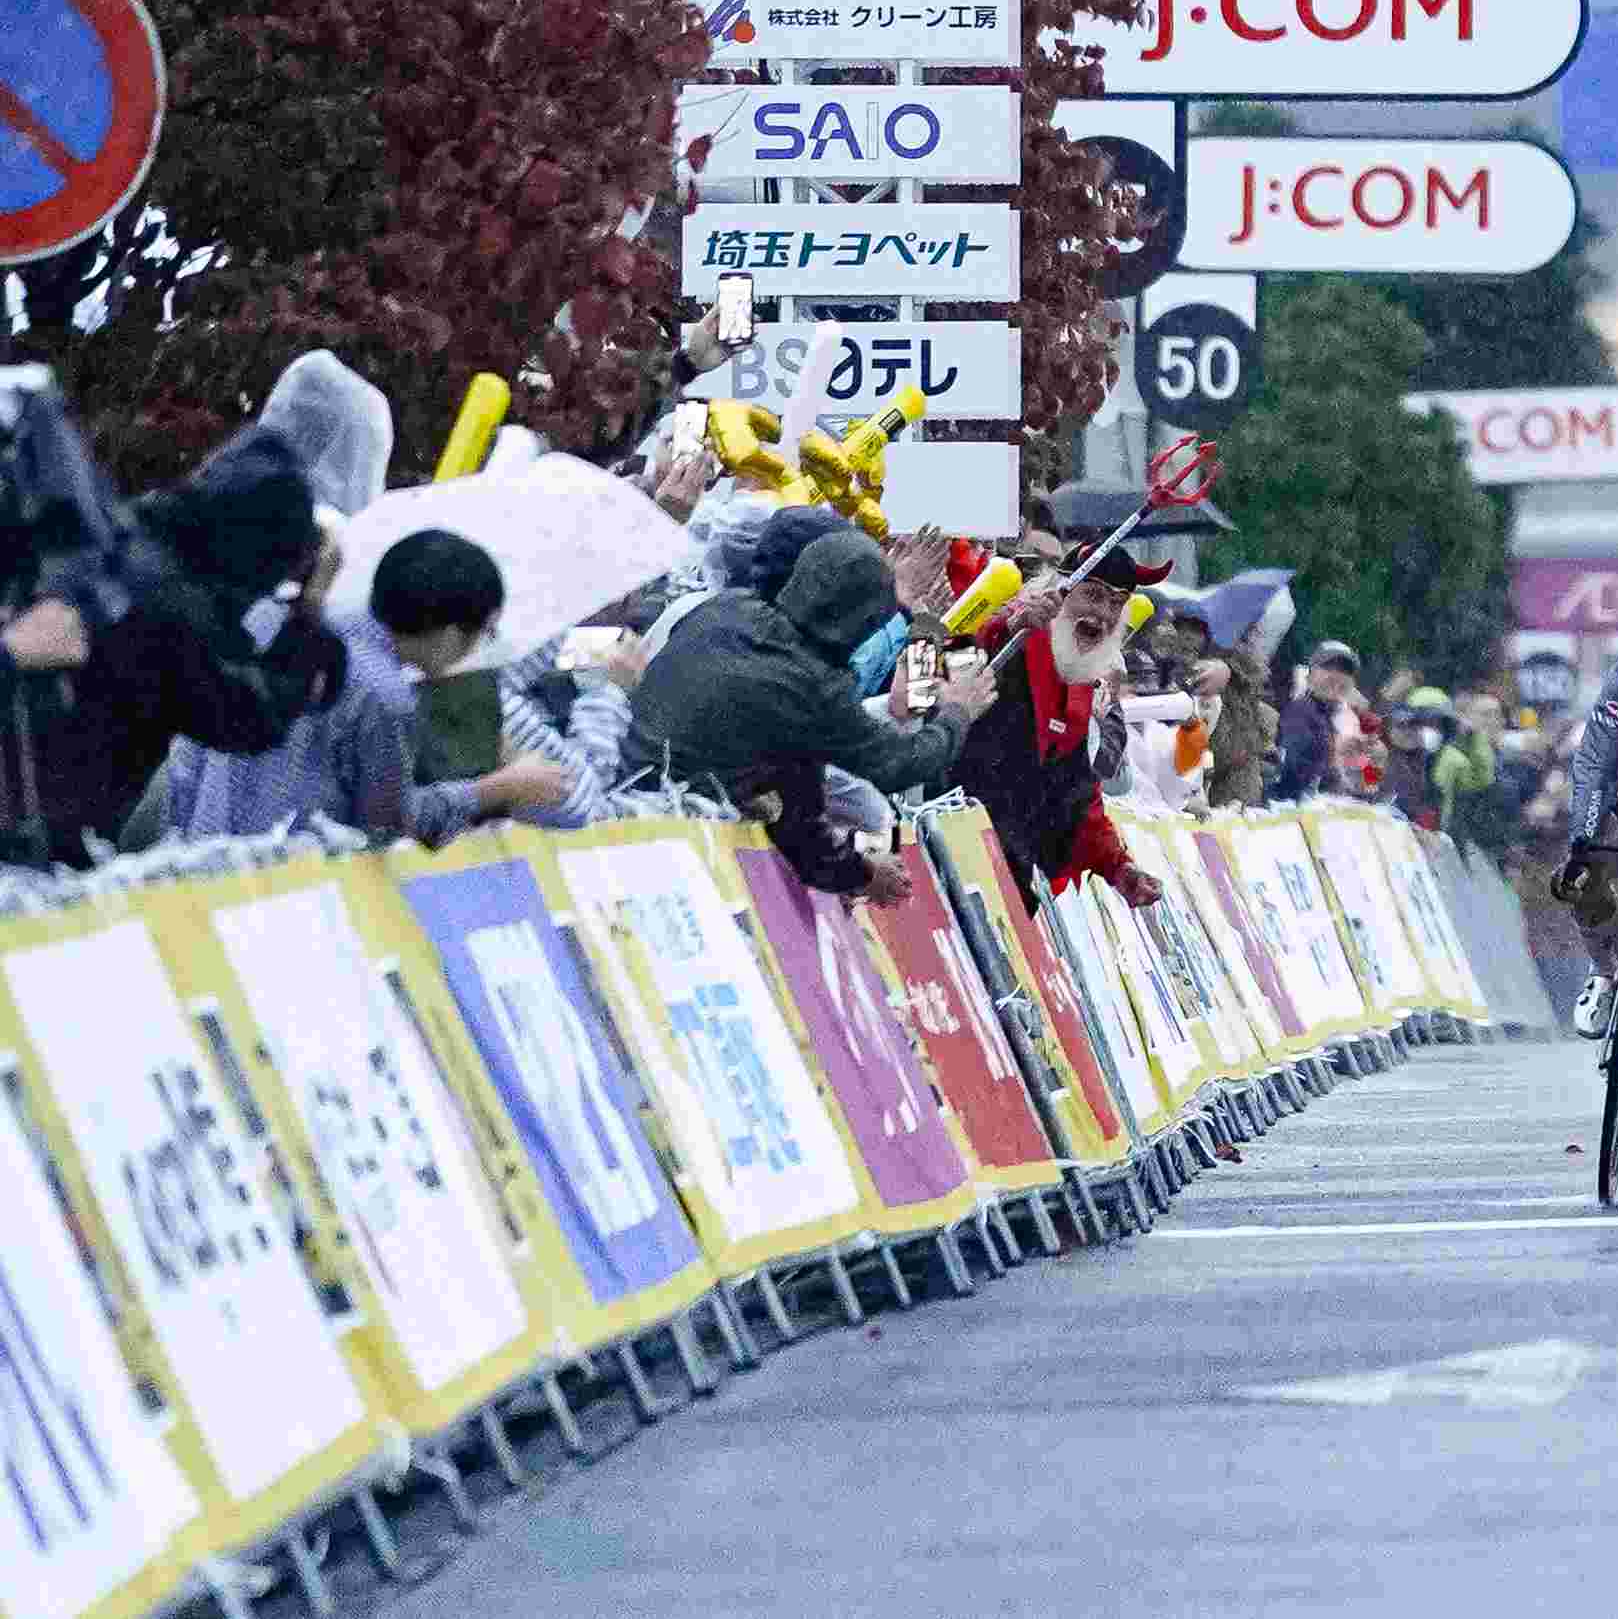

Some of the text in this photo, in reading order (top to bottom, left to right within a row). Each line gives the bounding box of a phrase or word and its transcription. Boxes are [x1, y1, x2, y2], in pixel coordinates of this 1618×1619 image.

[767, 6, 998, 30] 株式会社 クリーン工房
[1229, 164, 1492, 245] J:COM
[702, 231, 991, 270] 埼玉トヨペット
[1157, 335, 1240, 400] 50
[1476, 405, 1617, 453] COM
